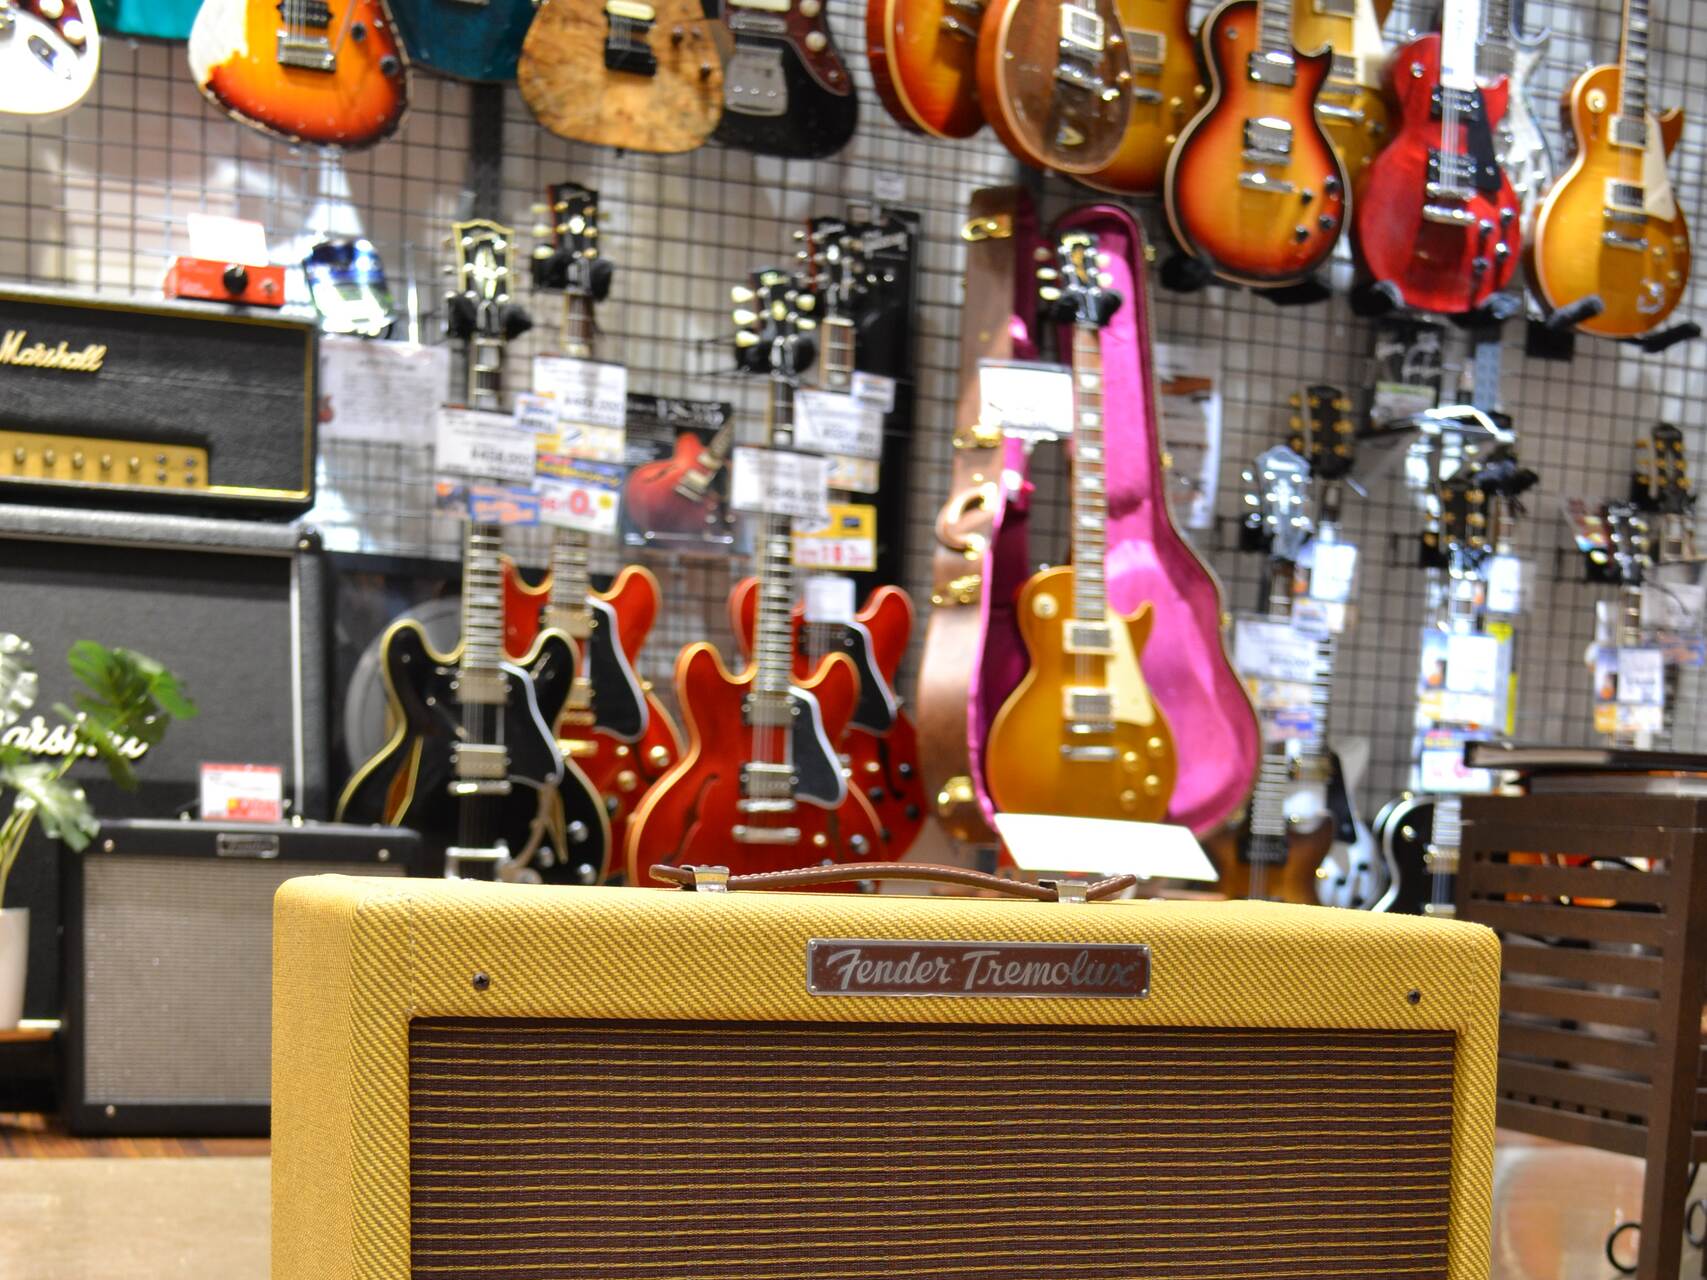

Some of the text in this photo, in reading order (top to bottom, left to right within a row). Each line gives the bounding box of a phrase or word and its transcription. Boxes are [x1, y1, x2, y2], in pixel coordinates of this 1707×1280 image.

[0, 329, 107, 372] Marshall
[826, 949, 1138, 990] Fender Tremolux
